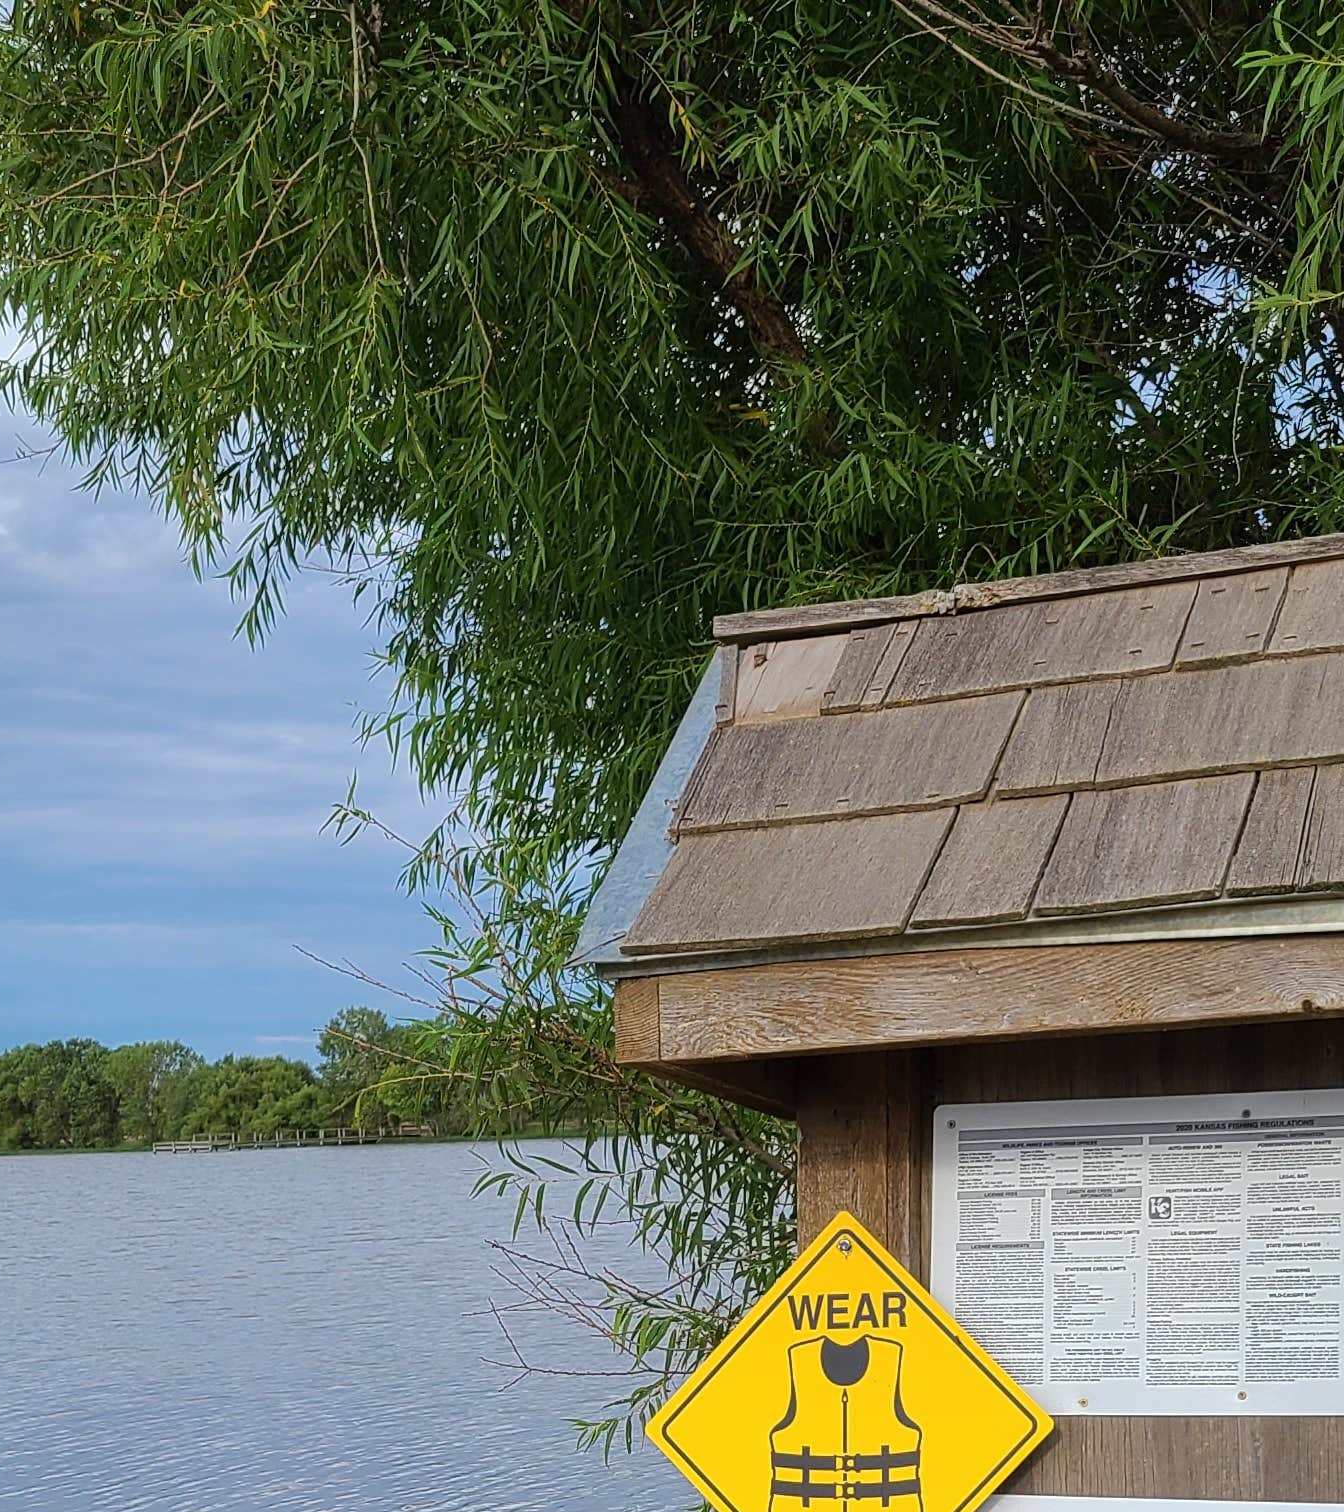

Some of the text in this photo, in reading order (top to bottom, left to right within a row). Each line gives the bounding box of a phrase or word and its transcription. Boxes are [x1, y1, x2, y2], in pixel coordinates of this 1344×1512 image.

[1194, 1122, 1226, 1130] KANSAS
[1228, 1121, 1258, 1129] FISHING
[1260, 1120, 1314, 1128] REGULATIONS
[788, 1292, 907, 1330] WEAR
